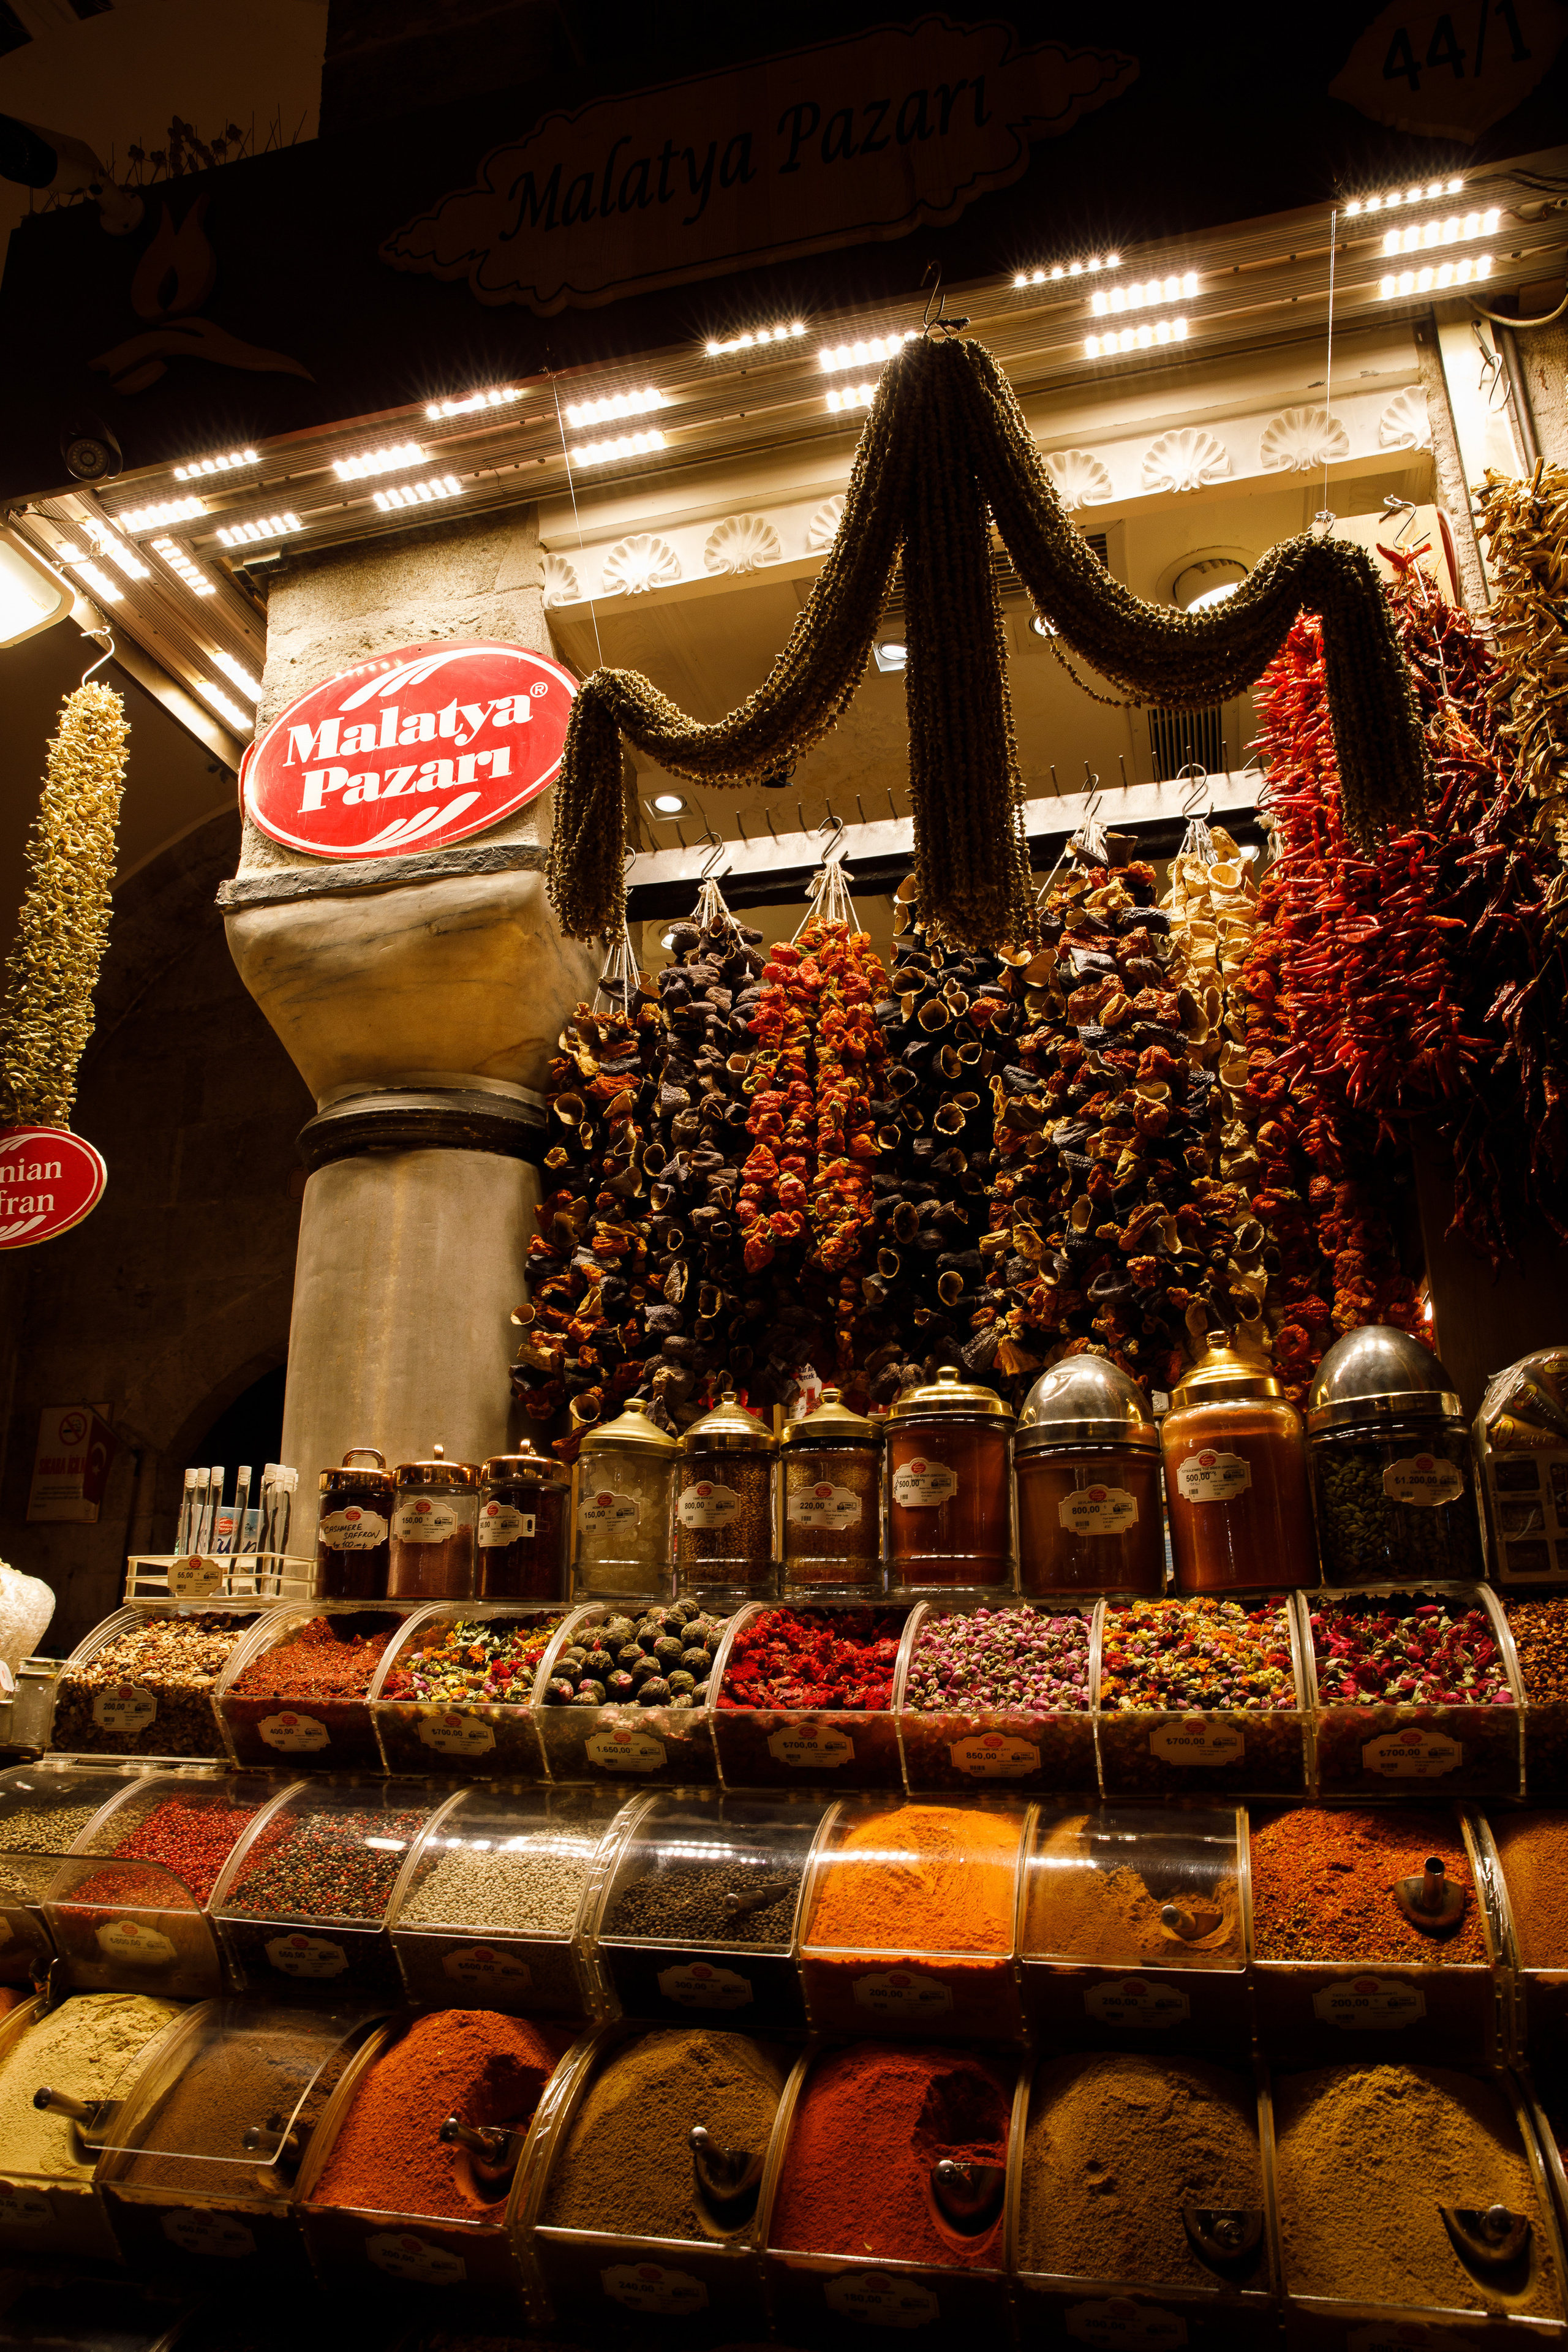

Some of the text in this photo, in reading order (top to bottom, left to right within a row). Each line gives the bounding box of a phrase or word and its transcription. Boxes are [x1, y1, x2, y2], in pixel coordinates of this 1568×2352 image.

[1382, 0, 1532, 91] 44/1
[499, 74, 992, 241] Malatya Pazarı
[282, 697, 534, 767] Malatya
[297, 746, 513, 814] Pazarı
[1186, 1472, 1210, 1482] 500,00
[1394, 1476, 1438, 1485] ₺1.200,00
[899, 1479, 919, 1488] 500,00
[684, 1501, 704, 1510] 800,00
[799, 1502, 825, 1510] 220,00
[1072, 1505, 1100, 1515] 800,00
[584, 1510, 605, 1519] 150,00
[324, 1523, 363, 1534] CASHMERE
[343, 1529, 380, 1540] SAFFRON
[431, 1728, 462, 1737] ₺700,00
[1166, 1737, 1205, 1746] ₺700,00
[596, 1746, 630, 1754] 1.650,00
[1379, 1748, 1420, 1757] ₺700,00
[458, 1962, 494, 1972] ₺500,00
[674, 1981, 706, 1990] 300,00
[869, 1988, 903, 1999] 200,00
[1102, 1997, 1138, 2007] 250,00
[1331, 1999, 1369, 2008] 200,00
[382, 2248, 415, 2263] 200,00
[619, 2281, 655, 2293] 240,00
[843, 2293, 882, 2304] 180,00
[1085, 2318, 1126, 2331] 200,00
